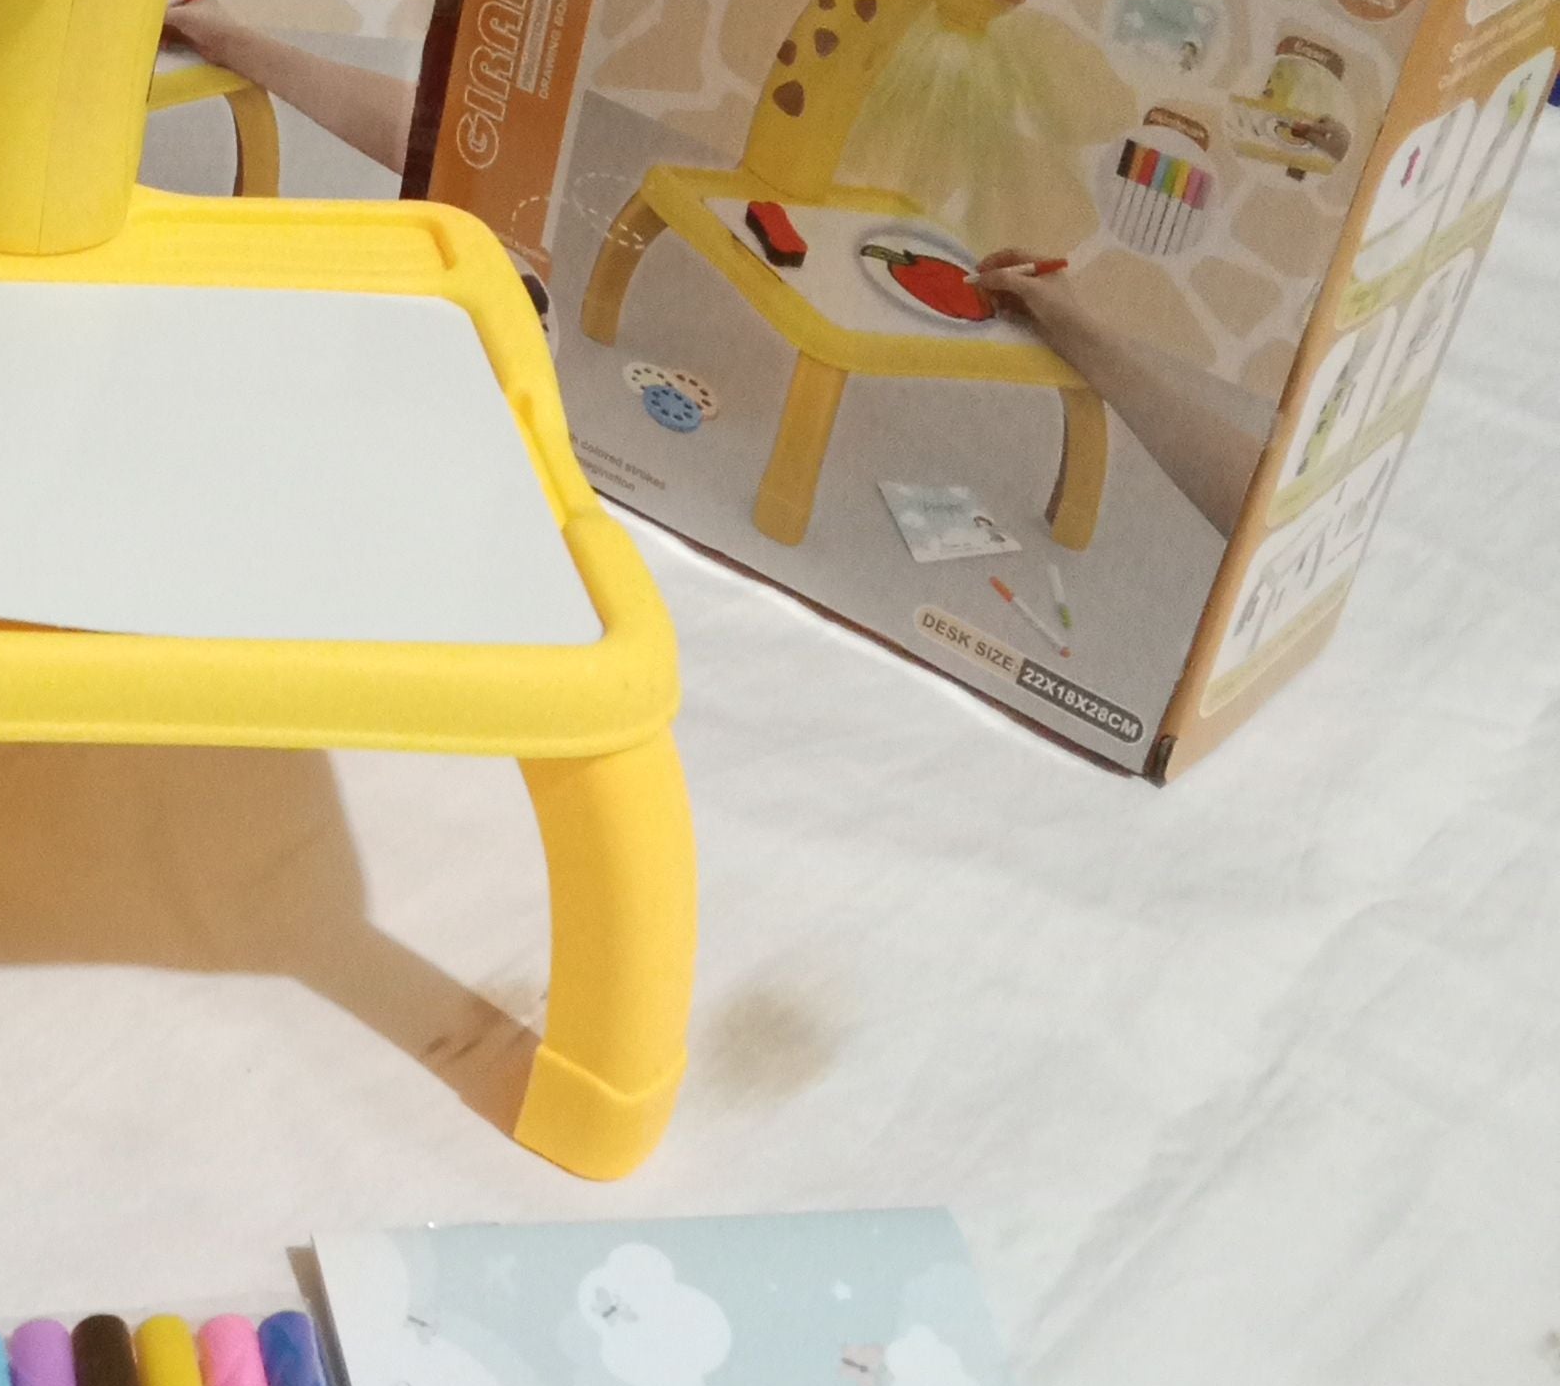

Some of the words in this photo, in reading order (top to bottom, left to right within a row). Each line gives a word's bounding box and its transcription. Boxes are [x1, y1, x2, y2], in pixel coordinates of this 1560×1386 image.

[538, 29, 563, 100] DRAWING
[922, 612, 973, 649] DESK
[1022, 667, 1139, 739] 22X18X28CM
